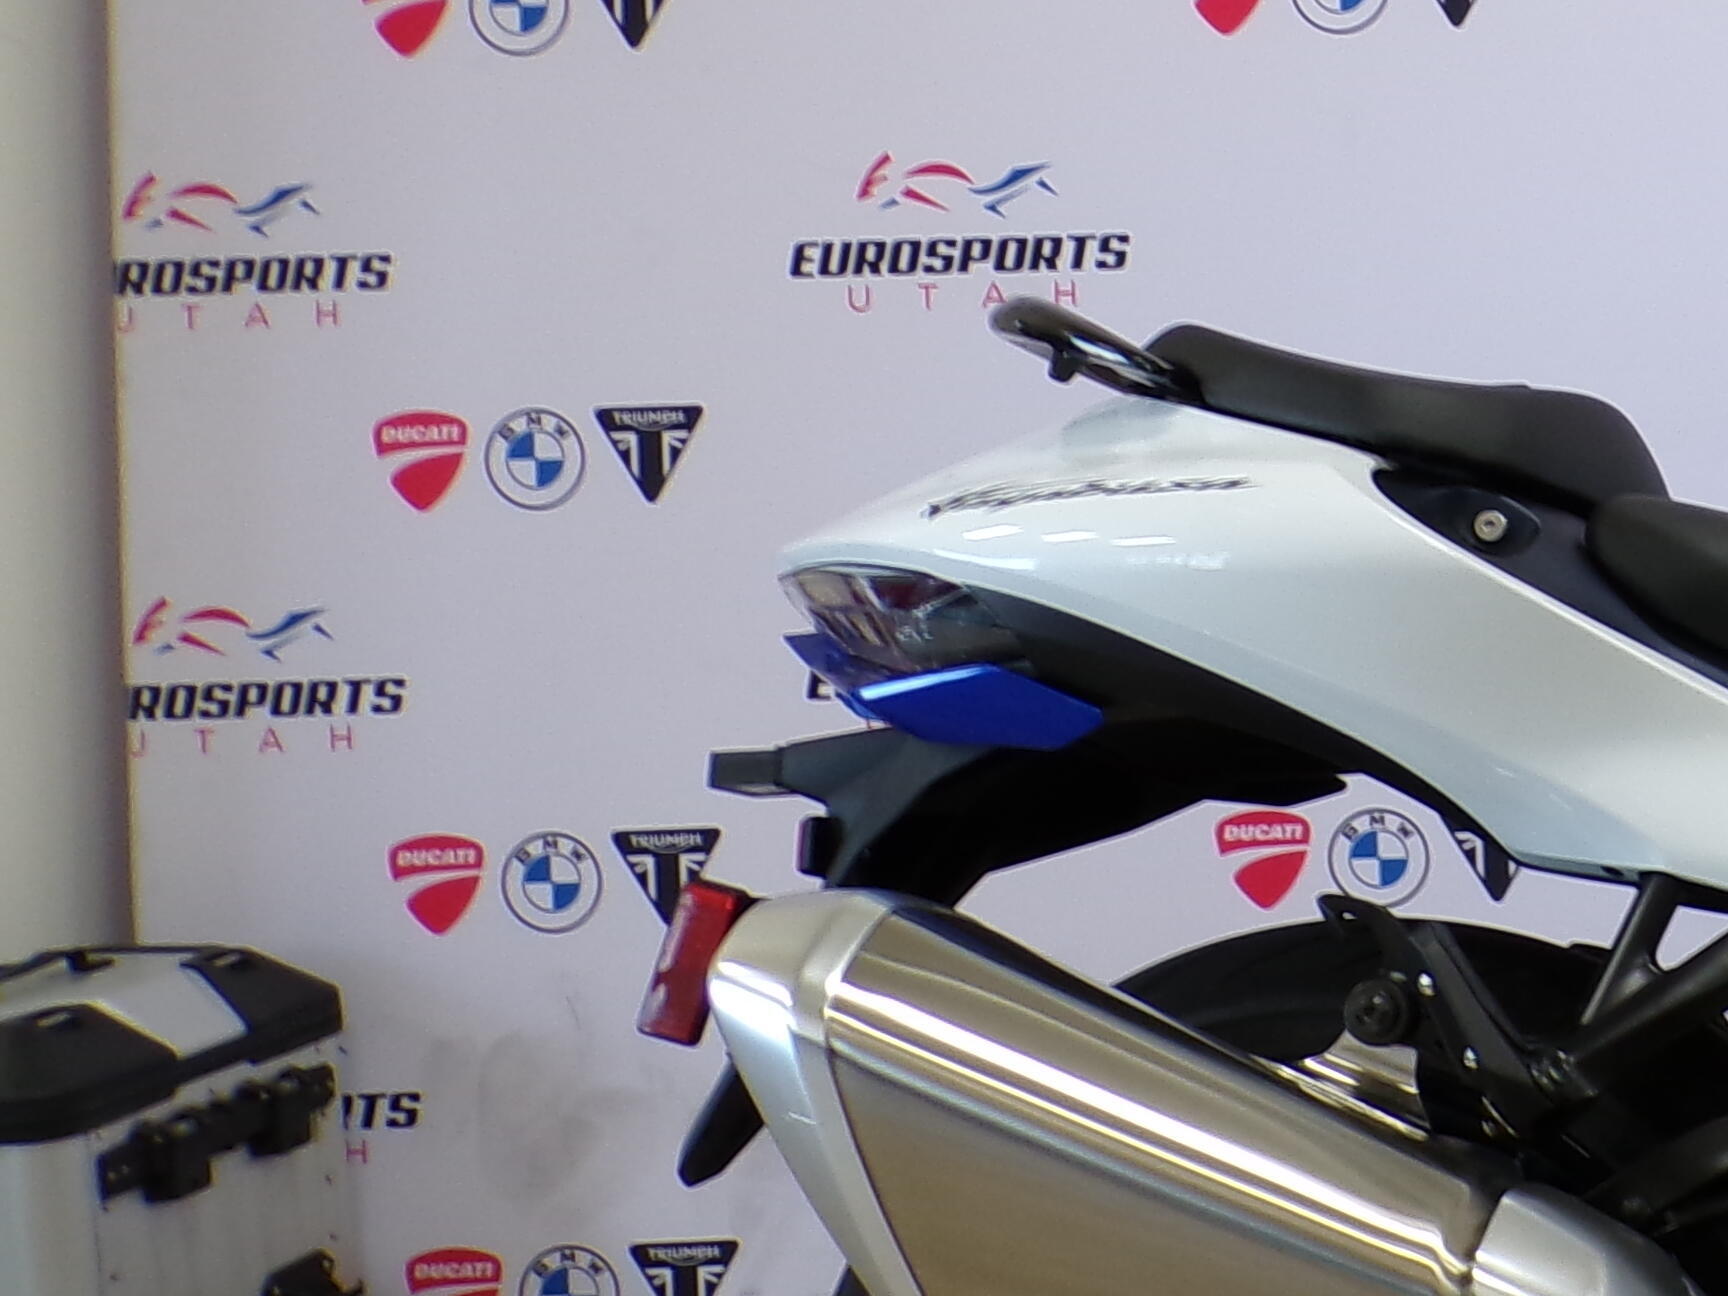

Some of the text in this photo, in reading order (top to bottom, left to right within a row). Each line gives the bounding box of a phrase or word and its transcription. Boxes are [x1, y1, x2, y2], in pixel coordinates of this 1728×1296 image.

[789, 233, 1131, 278] EUROSPORTS
[114, 254, 391, 297] ROSPORTS
[846, 281, 1080, 314] UTAH
[382, 423, 459, 444] DUCATI
[630, 832, 703, 848] TRIUMPH
[1222, 821, 1304, 842] DUCATI
[398, 848, 476, 868] DUCATI
[648, 1244, 720, 1260] TRIUMPH
[414, 1260, 493, 1280] DUCATI
